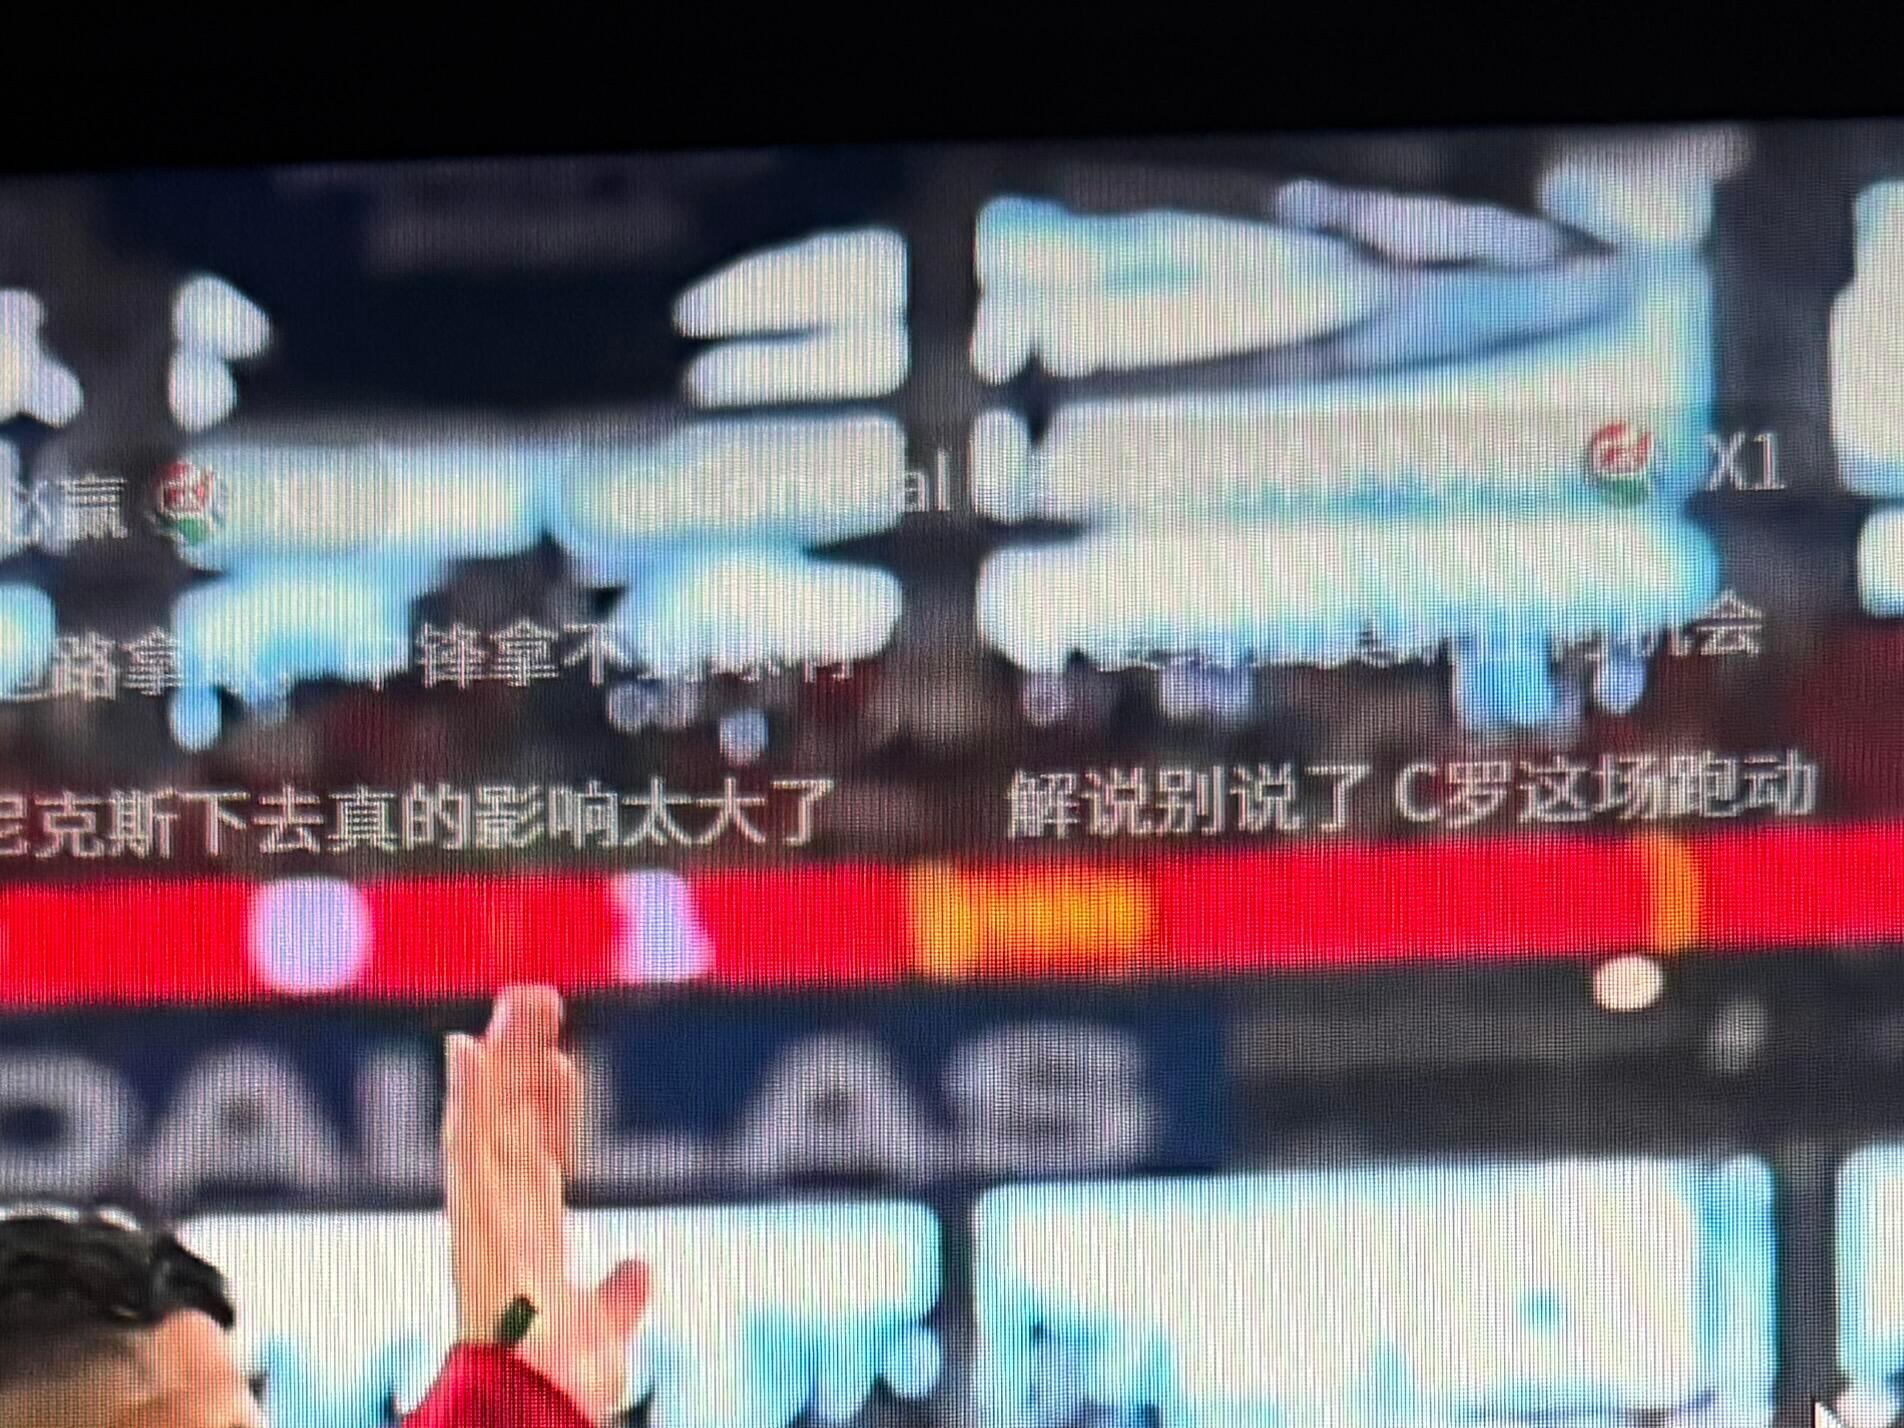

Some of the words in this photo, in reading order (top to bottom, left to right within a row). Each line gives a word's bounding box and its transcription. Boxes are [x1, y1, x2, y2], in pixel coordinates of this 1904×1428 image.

[1704, 434, 1786, 490] X1
[1008, 761, 1370, 840] 解说别说了
[1395, 748, 1818, 828] C罗这场跑动
